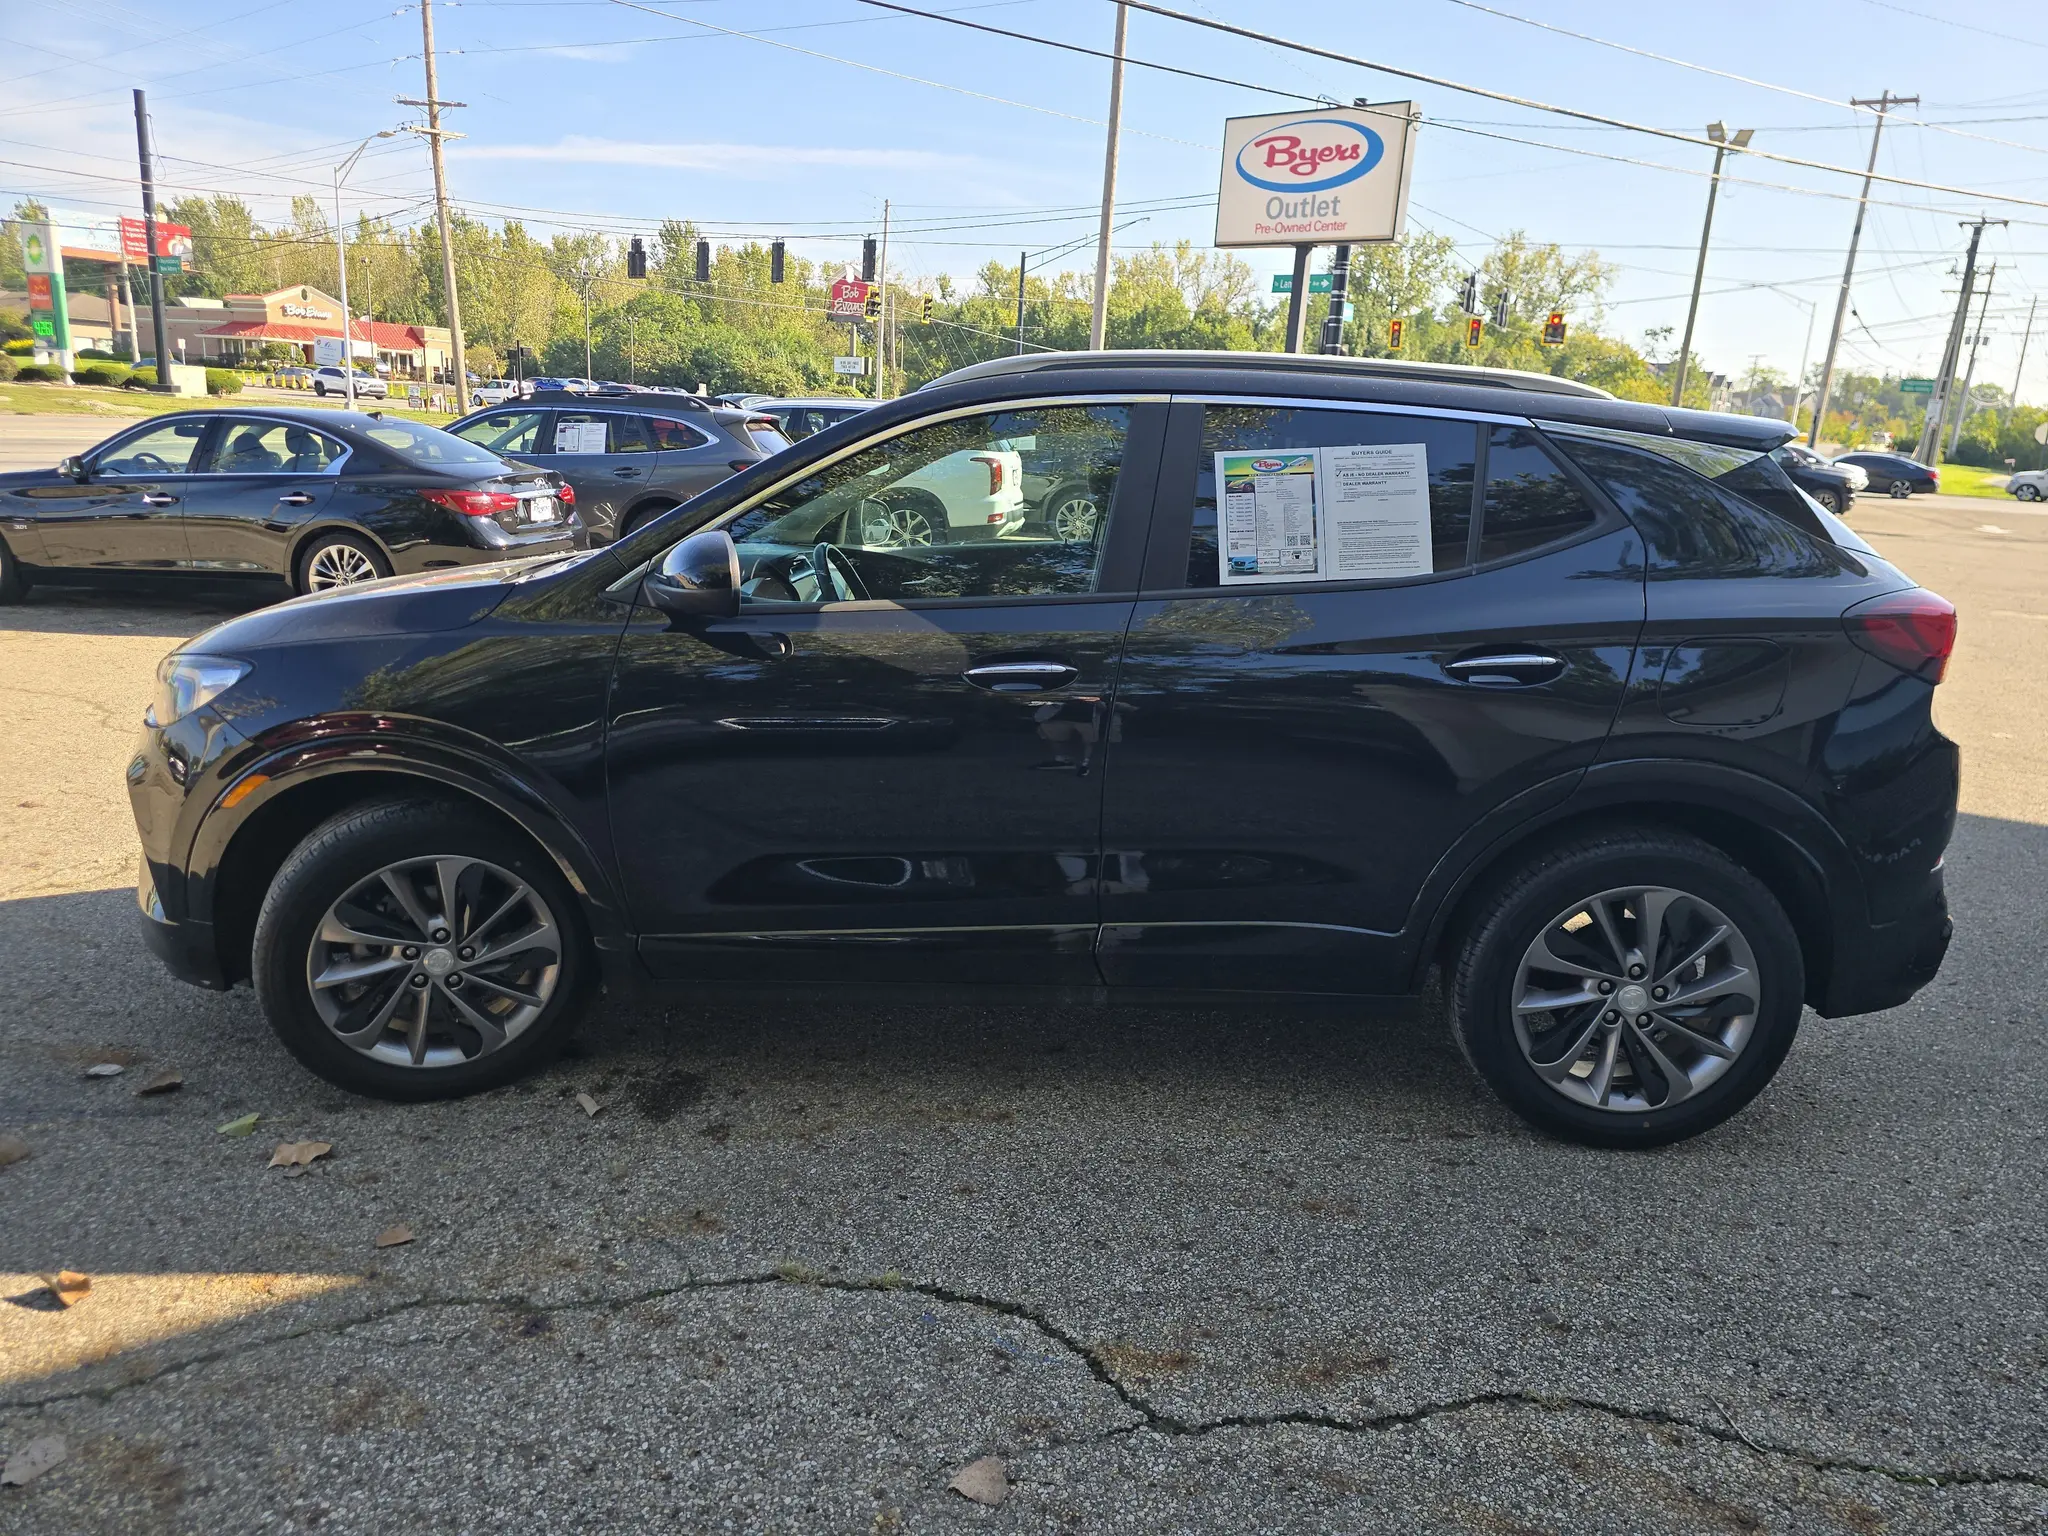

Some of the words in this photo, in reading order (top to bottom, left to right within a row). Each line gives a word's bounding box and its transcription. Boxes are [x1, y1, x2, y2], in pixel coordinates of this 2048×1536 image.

[1254, 136, 1360, 176] Byers
[1265, 194, 1341, 220] Outlet
[1254, 221, 1311, 235] Pre-Owned
[1313, 220, 1348, 233] Center
[841, 285, 859, 299] Bob
[284, 303, 306, 316] Bob
[306, 306, 333, 319] Evans
[834, 298, 865, 315] Evans
